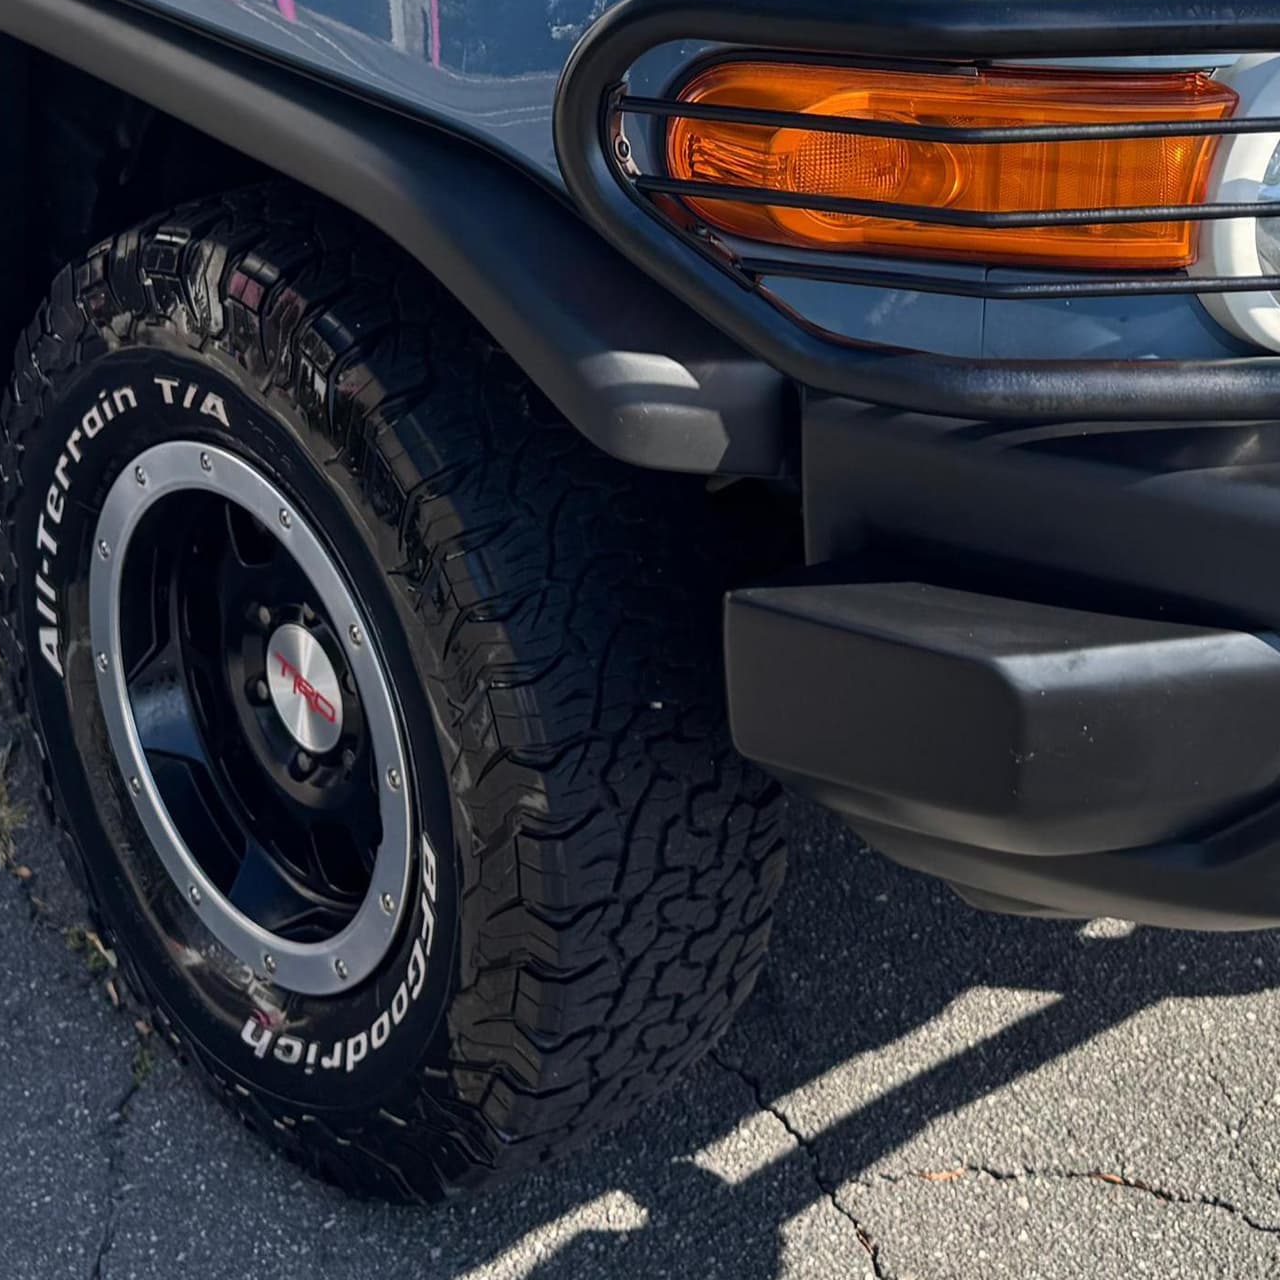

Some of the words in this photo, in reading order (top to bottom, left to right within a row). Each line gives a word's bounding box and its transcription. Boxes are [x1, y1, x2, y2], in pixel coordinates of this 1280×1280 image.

[35, 384, 139, 678] All-Terrain
[153, 375, 231, 428] T/A
[274, 649, 337, 724] TRD
[240, 831, 438, 1076] BFGoodrich
